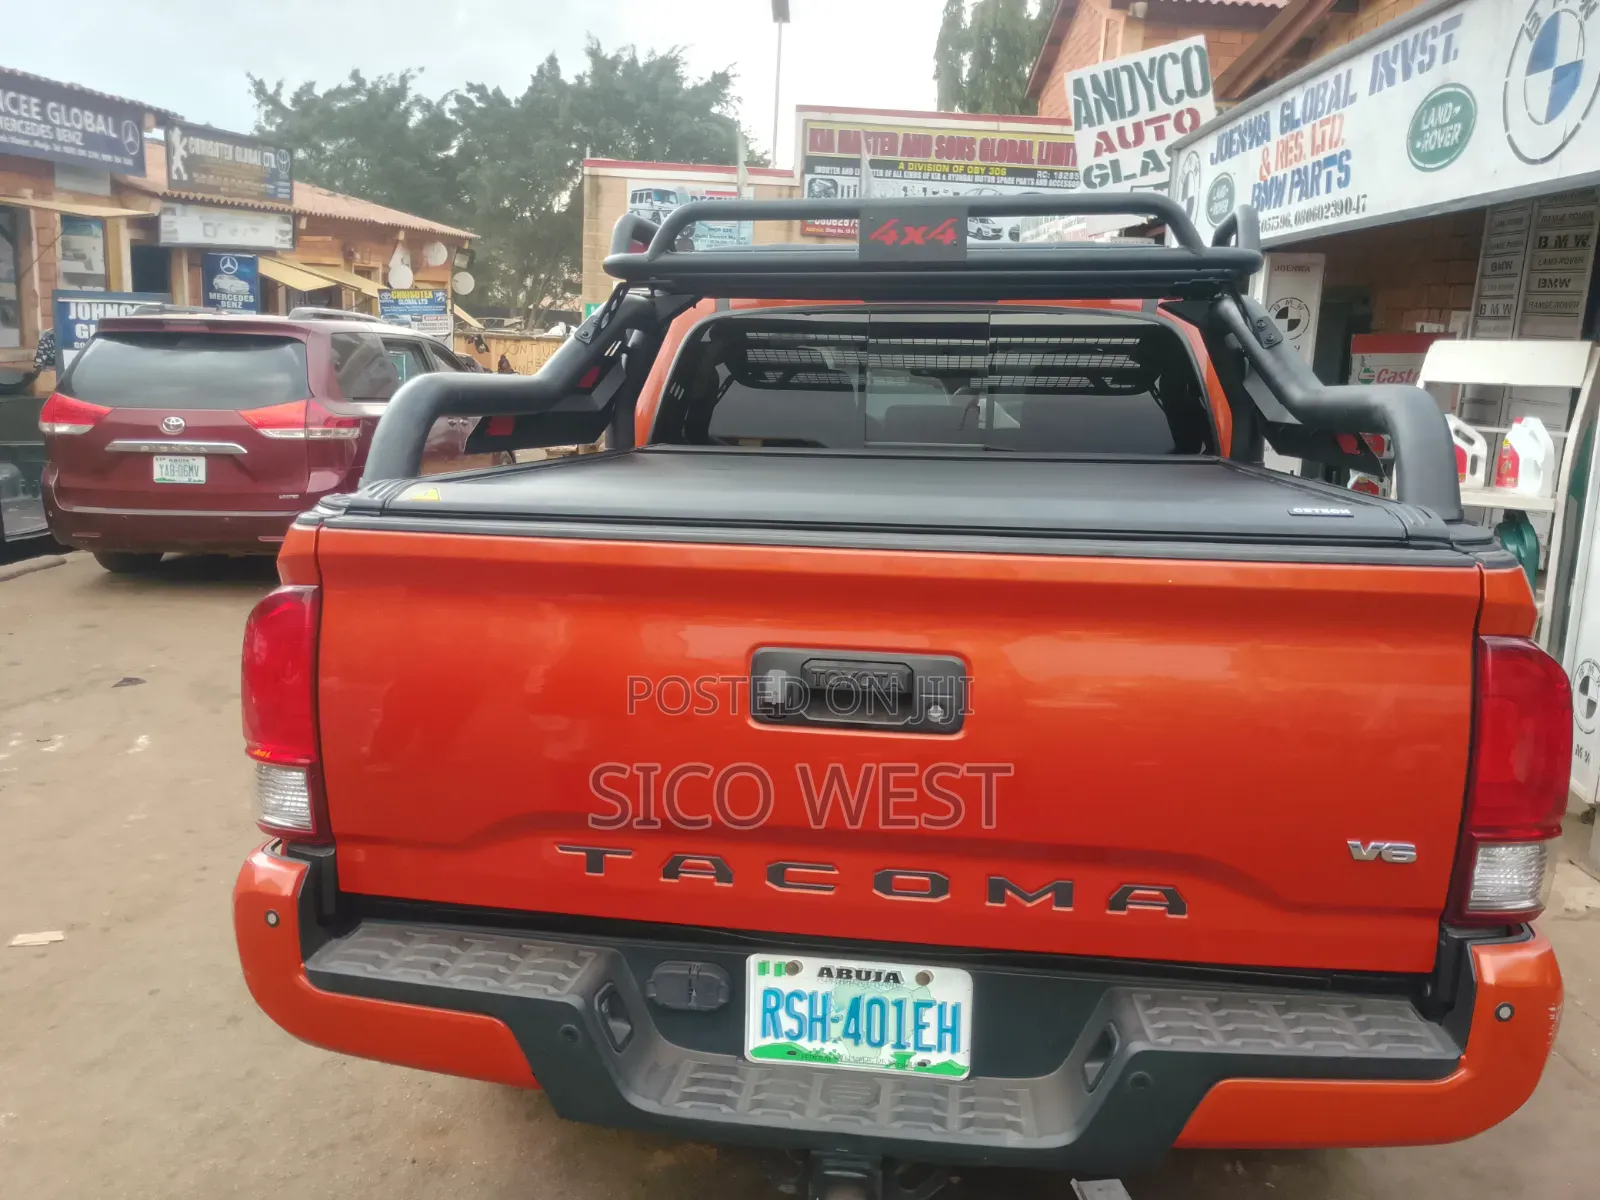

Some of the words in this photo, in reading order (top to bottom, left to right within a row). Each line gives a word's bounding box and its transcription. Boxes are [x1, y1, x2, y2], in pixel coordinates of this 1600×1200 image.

[1072, 44, 1211, 131] ANDYCO
[1279, 68, 1357, 136] GLOBAL
[47, 101, 118, 138] GLOBAL
[1420, 102, 1453, 131] LAND
[1093, 107, 1202, 158] AUTO
[1420, 122, 1462, 153] ROVER
[935, 134, 976, 161] SONS
[979, 137, 1034, 165] GLOBAL
[898, 162, 905, 170] A
[907, 163, 949, 173] DIVISION
[952, 165, 965, 174] OF
[967, 166, 986, 175] OBY
[989, 167, 1007, 176] 306
[1251, 173, 1287, 213] BMW
[1288, 149, 1352, 205] PARTS
[869, 217, 958, 246] 4x4
[209, 292, 254, 303] MERCEDES
[221, 300, 242, 309] BENZ
[811, 669, 904, 691] TOYOTA
[1346, 840, 1417, 863] V6
[555, 844, 1188, 918] TACOMA
[817, 966, 902, 984] ABUJA
[760, 986, 962, 1055] RSH-401EH
